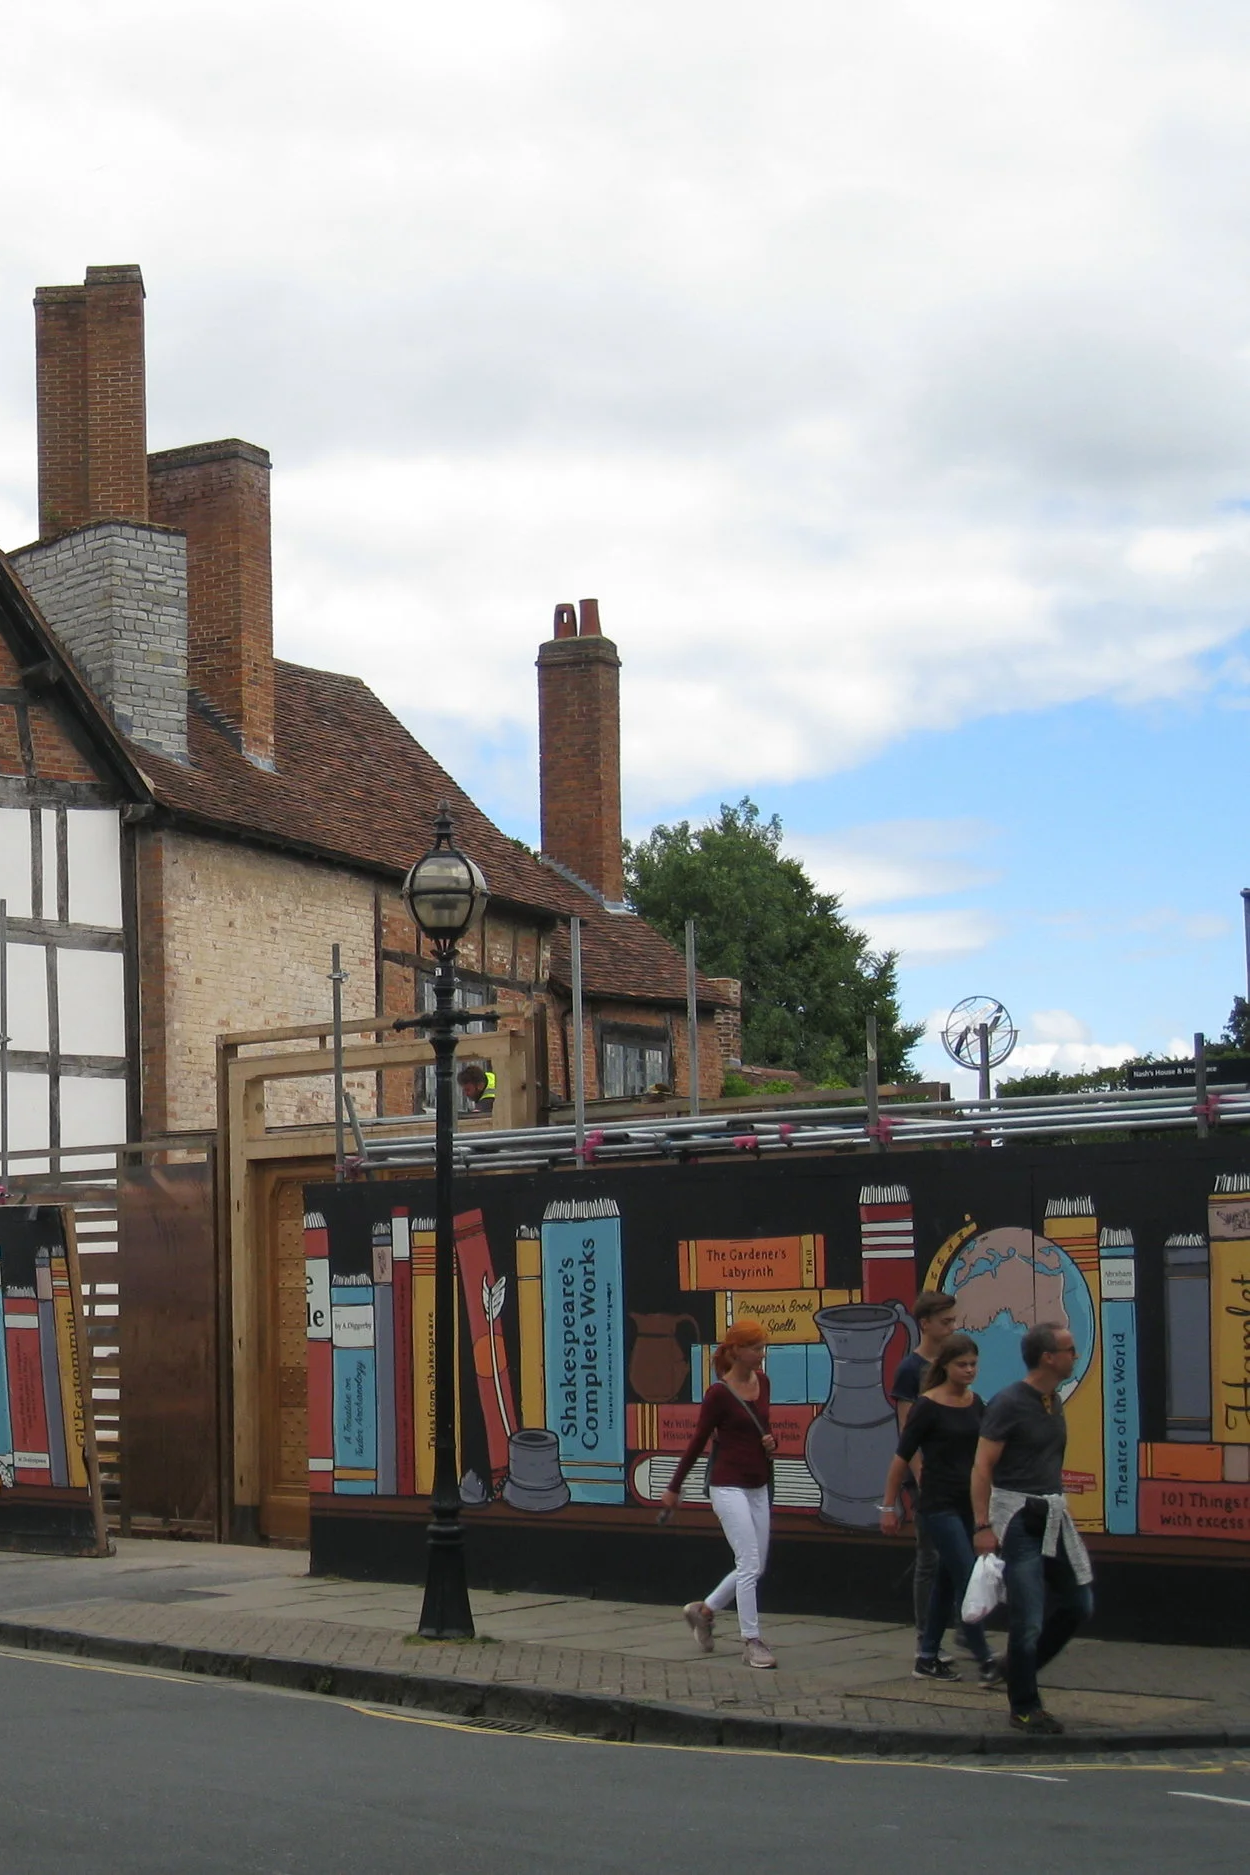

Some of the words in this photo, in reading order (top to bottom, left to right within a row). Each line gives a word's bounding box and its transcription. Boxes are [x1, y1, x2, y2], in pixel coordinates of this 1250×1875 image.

[1133, 1069, 1154, 1078] Nash's
[1155, 1068, 1176, 1076] House
[1176, 1067, 1183, 1075] &
[706, 1249, 726, 1261] The
[729, 1248, 787, 1261] Gardener's
[578, 1238, 597, 1319] Works
[722, 1265, 774, 1280] Labyrinth
[737, 1300, 786, 1316] Prospero's
[788, 1299, 814, 1313] Book
[767, 1319, 797, 1333] Spells
[427, 1311, 436, 1387] Shakespeare
[557, 1257, 579, 1437] Shakespeare's
[1112, 1332, 1126, 1384] World
[344, 1377, 351, 1391] on
[581, 1323, 602, 1450] Complete
[427, 1393, 436, 1418] from
[1113, 1387, 1127, 1414] the
[343, 1393, 352, 1433] Treatise
[675, 1418, 698, 1428] Willia
[427, 1419, 436, 1450] Tales
[770, 1419, 800, 1430] medies,
[1113, 1416, 1126, 1436] of
[344, 1435, 352, 1445] A
[354, 1429, 363, 1457] Tudor
[663, 1431, 693, 1440] Historie
[1114, 1441, 1129, 1508] Theatre
[1161, 1491, 1184, 1507] 101
[1188, 1491, 1242, 1513] Things
[1160, 1512, 1192, 1527] with
[1197, 1516, 1244, 1530] excess
